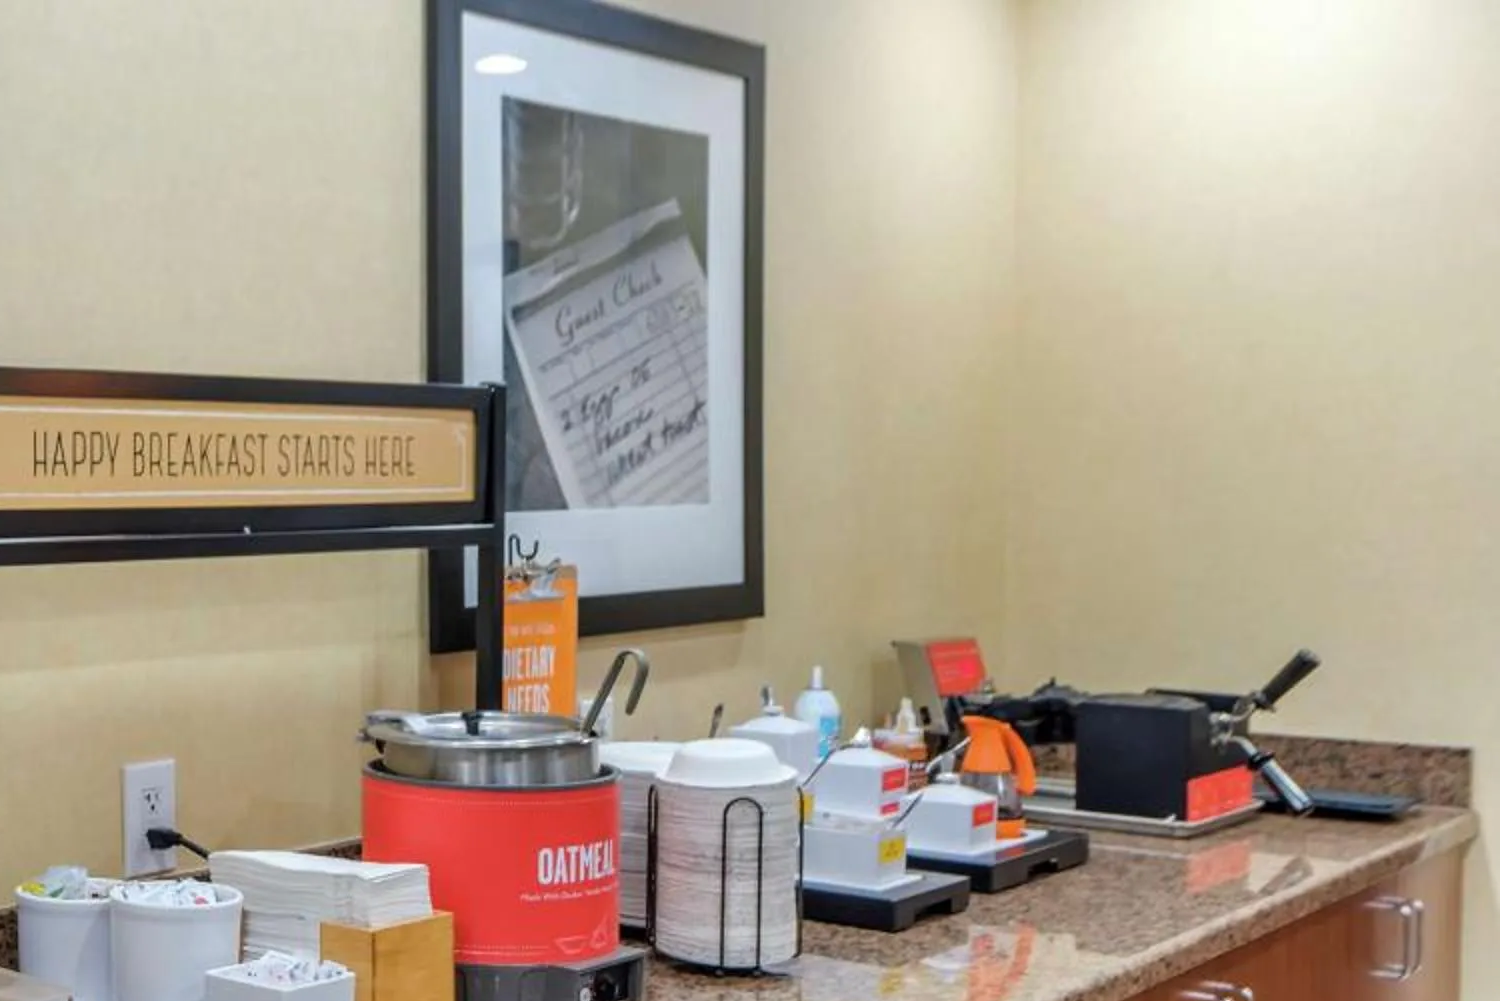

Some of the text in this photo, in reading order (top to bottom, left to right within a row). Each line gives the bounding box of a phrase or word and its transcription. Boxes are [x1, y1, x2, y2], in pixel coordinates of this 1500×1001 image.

[31, 430, 418, 478] HAPPY BREAKFAST STARTS HERE
[537, 838, 615, 885] OATMEAL
